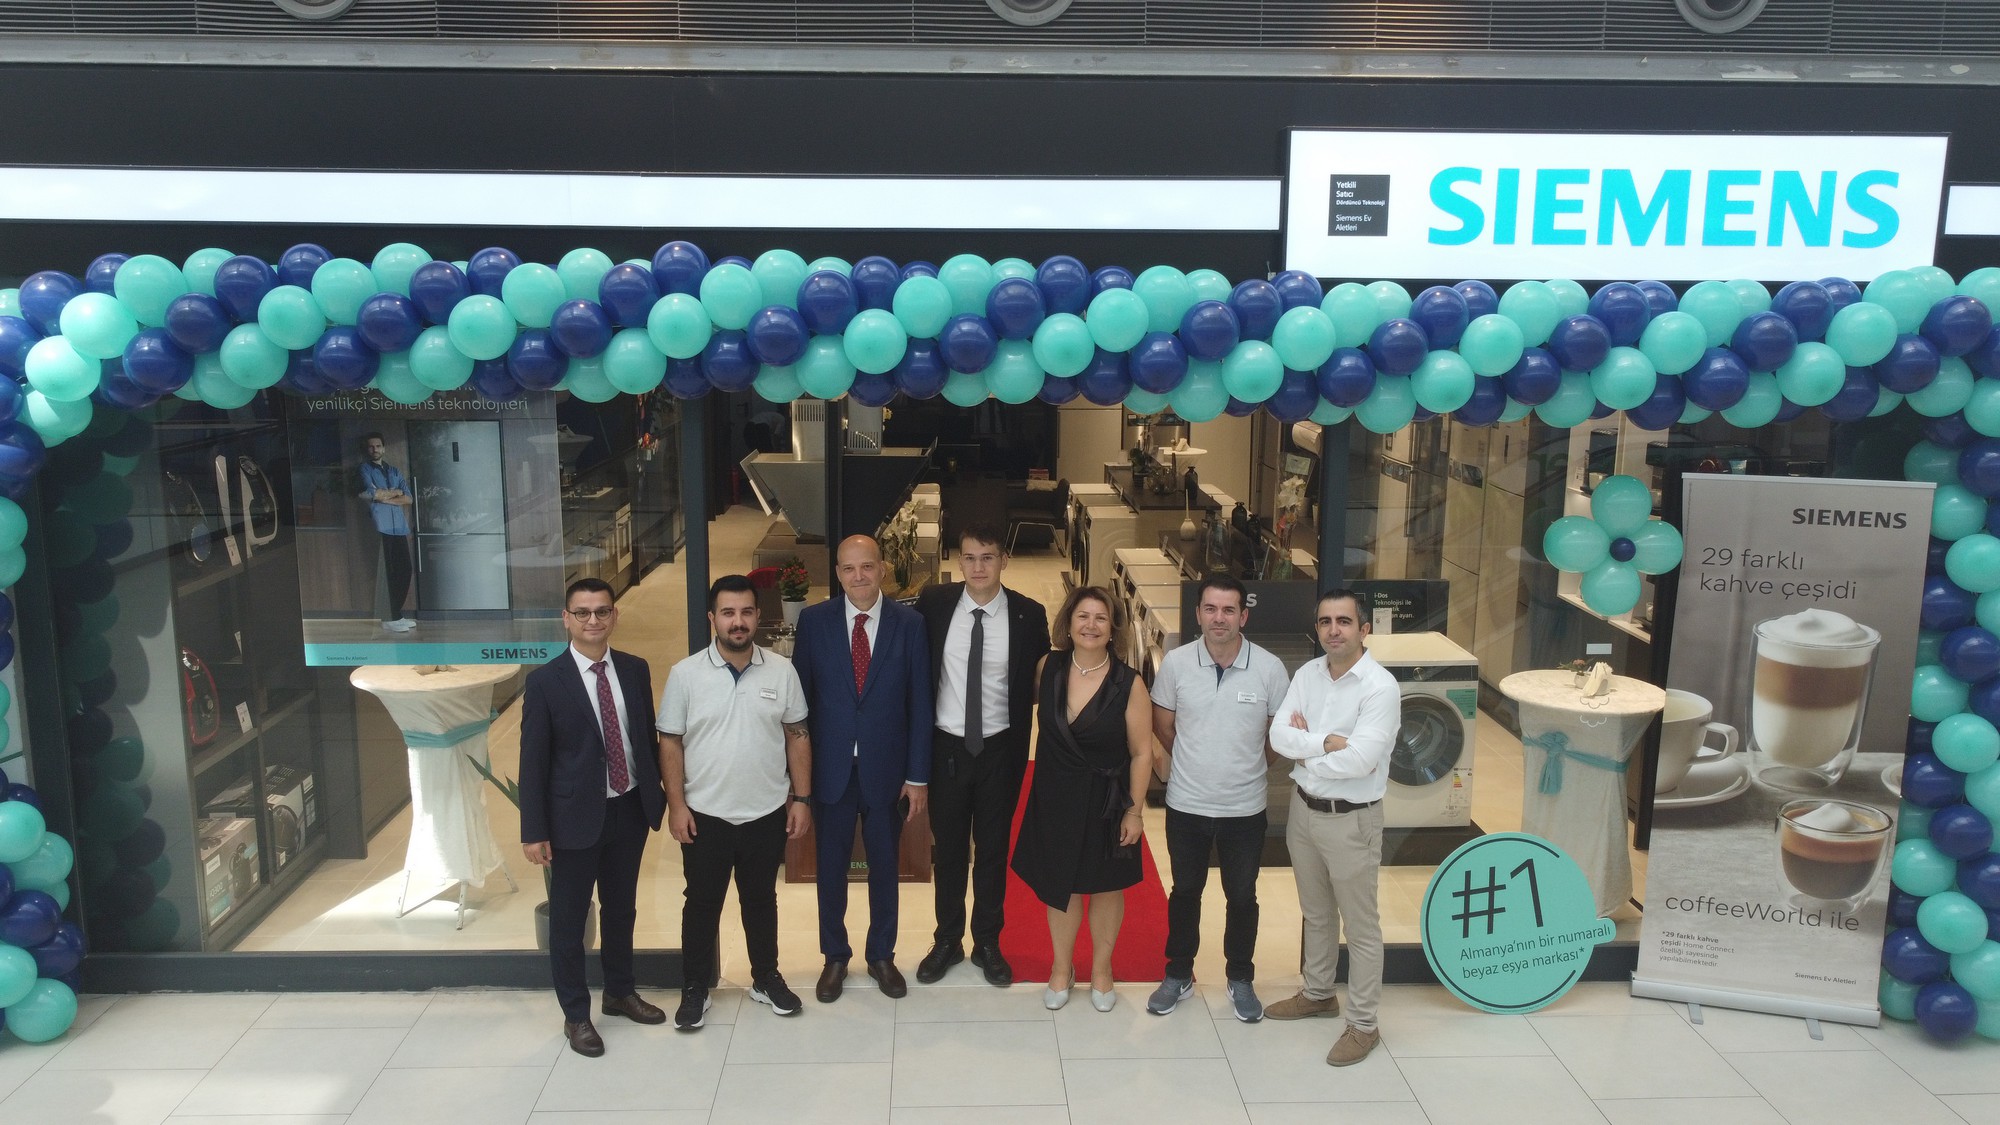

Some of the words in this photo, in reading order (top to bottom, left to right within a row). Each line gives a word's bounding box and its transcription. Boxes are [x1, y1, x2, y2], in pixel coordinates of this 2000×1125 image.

[1336, 181, 1357, 189] Yetkili
[1335, 190, 1354, 198] Satıcı
[1362, 199, 1386, 207] Teknoloji
[1427, 165, 1900, 249] SIEMENS
[1335, 214, 1363, 222] Siemens
[1363, 214, 1372, 222] Ev
[1335, 223, 1358, 231] Aletleri
[306, 396, 368, 413] yenilikçi
[1792, 508, 1907, 529] SIEMENS
[1701, 547, 1734, 566] 29
[1740, 548, 1805, 570] farklı
[1699, 572, 1774, 595] kahve
[1780, 579, 1857, 602] çeşidi
[1374, 599, 1404, 607] Teknolojisi
[481, 648, 548, 659] SIEMENS
[1451, 858, 1544, 939] #1
[1665, 895, 1822, 927] coffeeWorld
[1830, 911, 1860, 931] ile
[1460, 939, 1536, 961] Almanya'nın
[1539, 933, 1555, 948] bir
[1558, 923, 1611, 945] numaralı
[1676, 932, 1696, 940] farklı
[1697, 935, 1719, 944] kahve
[1660, 939, 1682, 947] çeşidi
[1683, 941, 1704, 949] Home
[1705, 944, 1735, 954] Connect
[1685, 950, 1719, 959] sayesinde
[1462, 963, 1499, 980] beyaz
[1502, 960, 1530, 975] eşya
[1794, 972, 1822, 981] Siemens
[1832, 977, 1857, 985] Aletleri
